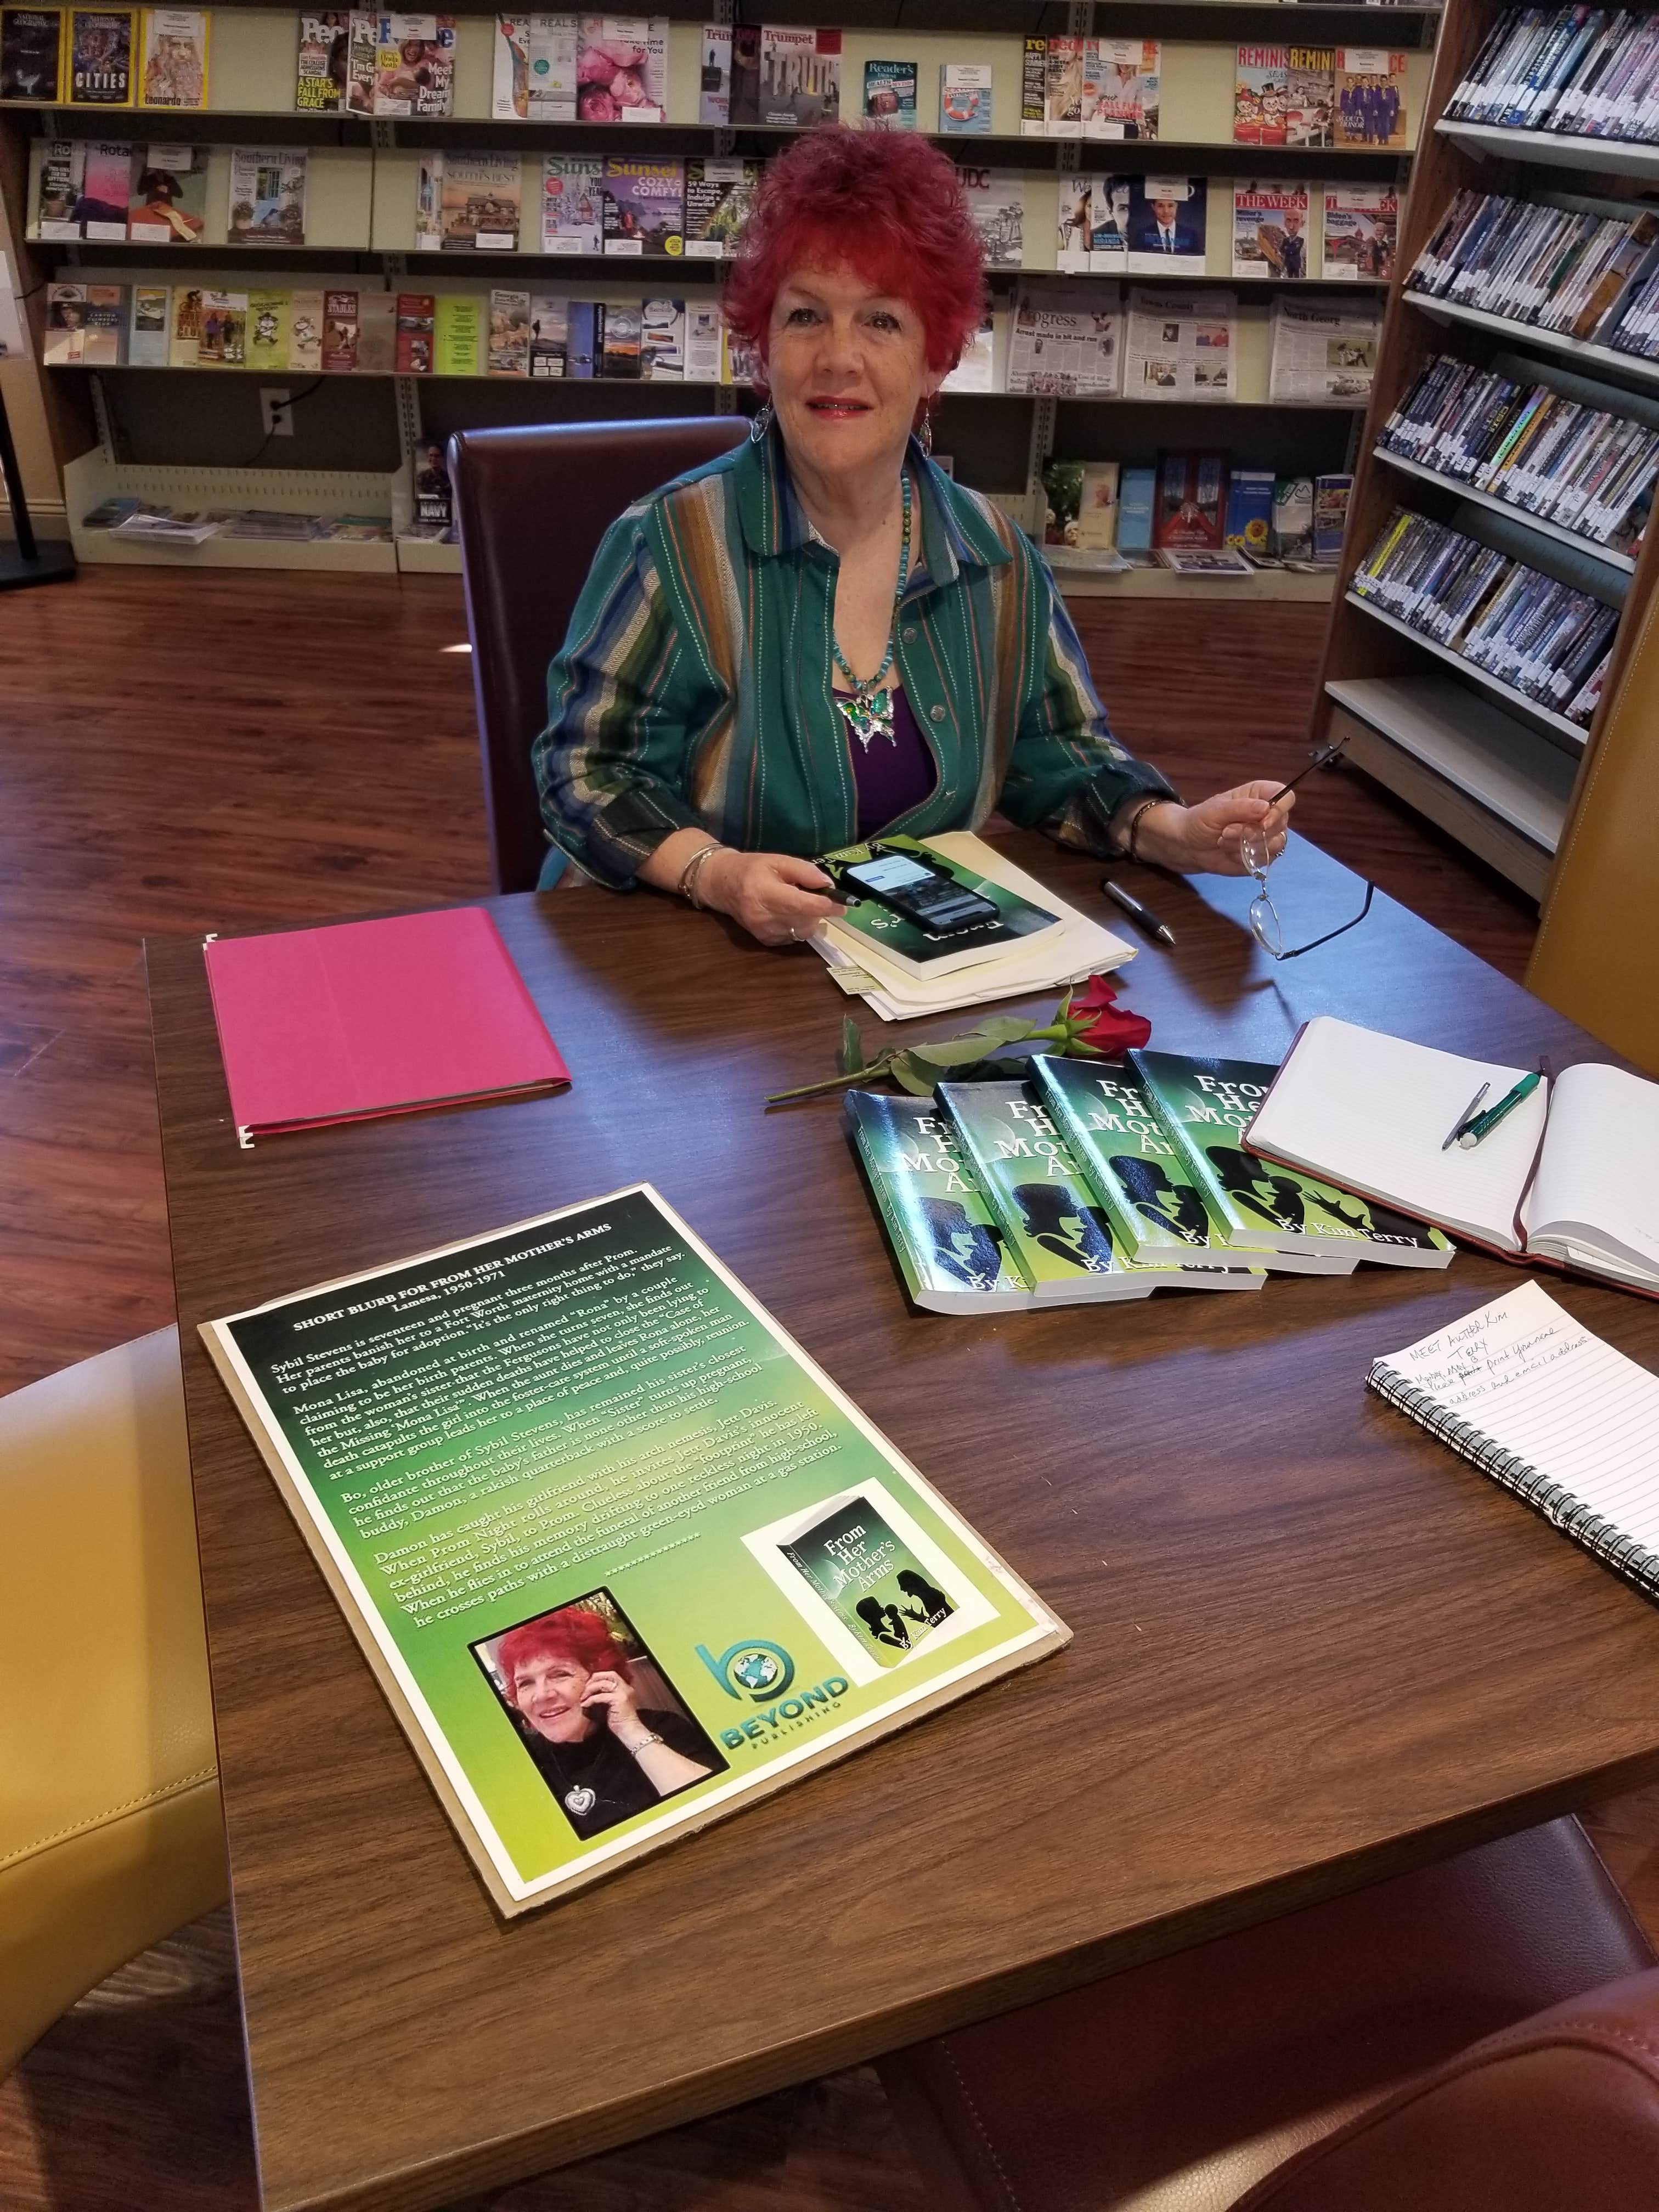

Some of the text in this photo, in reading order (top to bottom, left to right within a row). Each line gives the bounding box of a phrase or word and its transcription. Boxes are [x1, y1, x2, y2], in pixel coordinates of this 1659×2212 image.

[647, 46, 663, 54] You
[764, 30, 813, 46] Trumpet
[75, 72, 125, 88] CITIES
[869, 63, 914, 75] Reader's
[144, 95, 182, 106] Leonardo
[606, 157, 677, 178] Sunset
[1237, 195, 1307, 208] THE WEEK
[1045, 1087, 1056, 1109] From
[1053, 1101, 1063, 1119] Her
[1093, 1172, 1103, 1190] Kim
[1101, 1186, 1115, 1211] Terry
[857, 1125, 867, 1149] From
[890, 1212, 898, 1232] Kim
[895, 1228, 906, 1253] Terry
[1178, 1230, 1211, 1249] By
[1274, 1217, 1418, 1249] By Kim Terry
[292, 1222, 612, 1331] SHORT BLURB FOR FROM HER MOTHER'S ARMS
[391, 1269, 506, 1312] Lamesa, 1950-1971
[966, 1275, 1000, 1293] By
[270, 1249, 638, 1374] Sybil Stevens is seventeen and pregnant three months after Prom.
[291, 1398, 334, 1415] Mona
[334, 1387, 369, 1402] Lisa,
[370, 1358, 442, 1389] abandoned
[443, 1355, 458, 1364] at
[456, 1342, 492, 1359] birth
[492, 1333, 517, 1347] and
[518, 1313, 570, 1339] renamed
[568, 1299, 610, 1317] "Rona"
[612, 1294, 628, 1304] by
[640, 1276, 678, 1294] couple
[358, 1517, 409, 1539] buddy,
[409, 1498, 467, 1522] Damon,
[479, 1474, 520, 1497] rakish
[521, 1444, 596, 1480] quarterback
[596, 1432, 626, 1448] with
[636, 1417, 668, 1434] score
[668, 1411, 682, 1420] to
[682, 1397, 718, 1414] settle.
[822, 1523, 867, 1557] From
[838, 1539, 868, 1566] Her
[832, 1538, 897, 1589] Mother's
[857, 1558, 896, 1593] Arms
[899, 1606, 948, 1651] By Kim Terry
[719, 1677, 849, 1750] BEYOND
